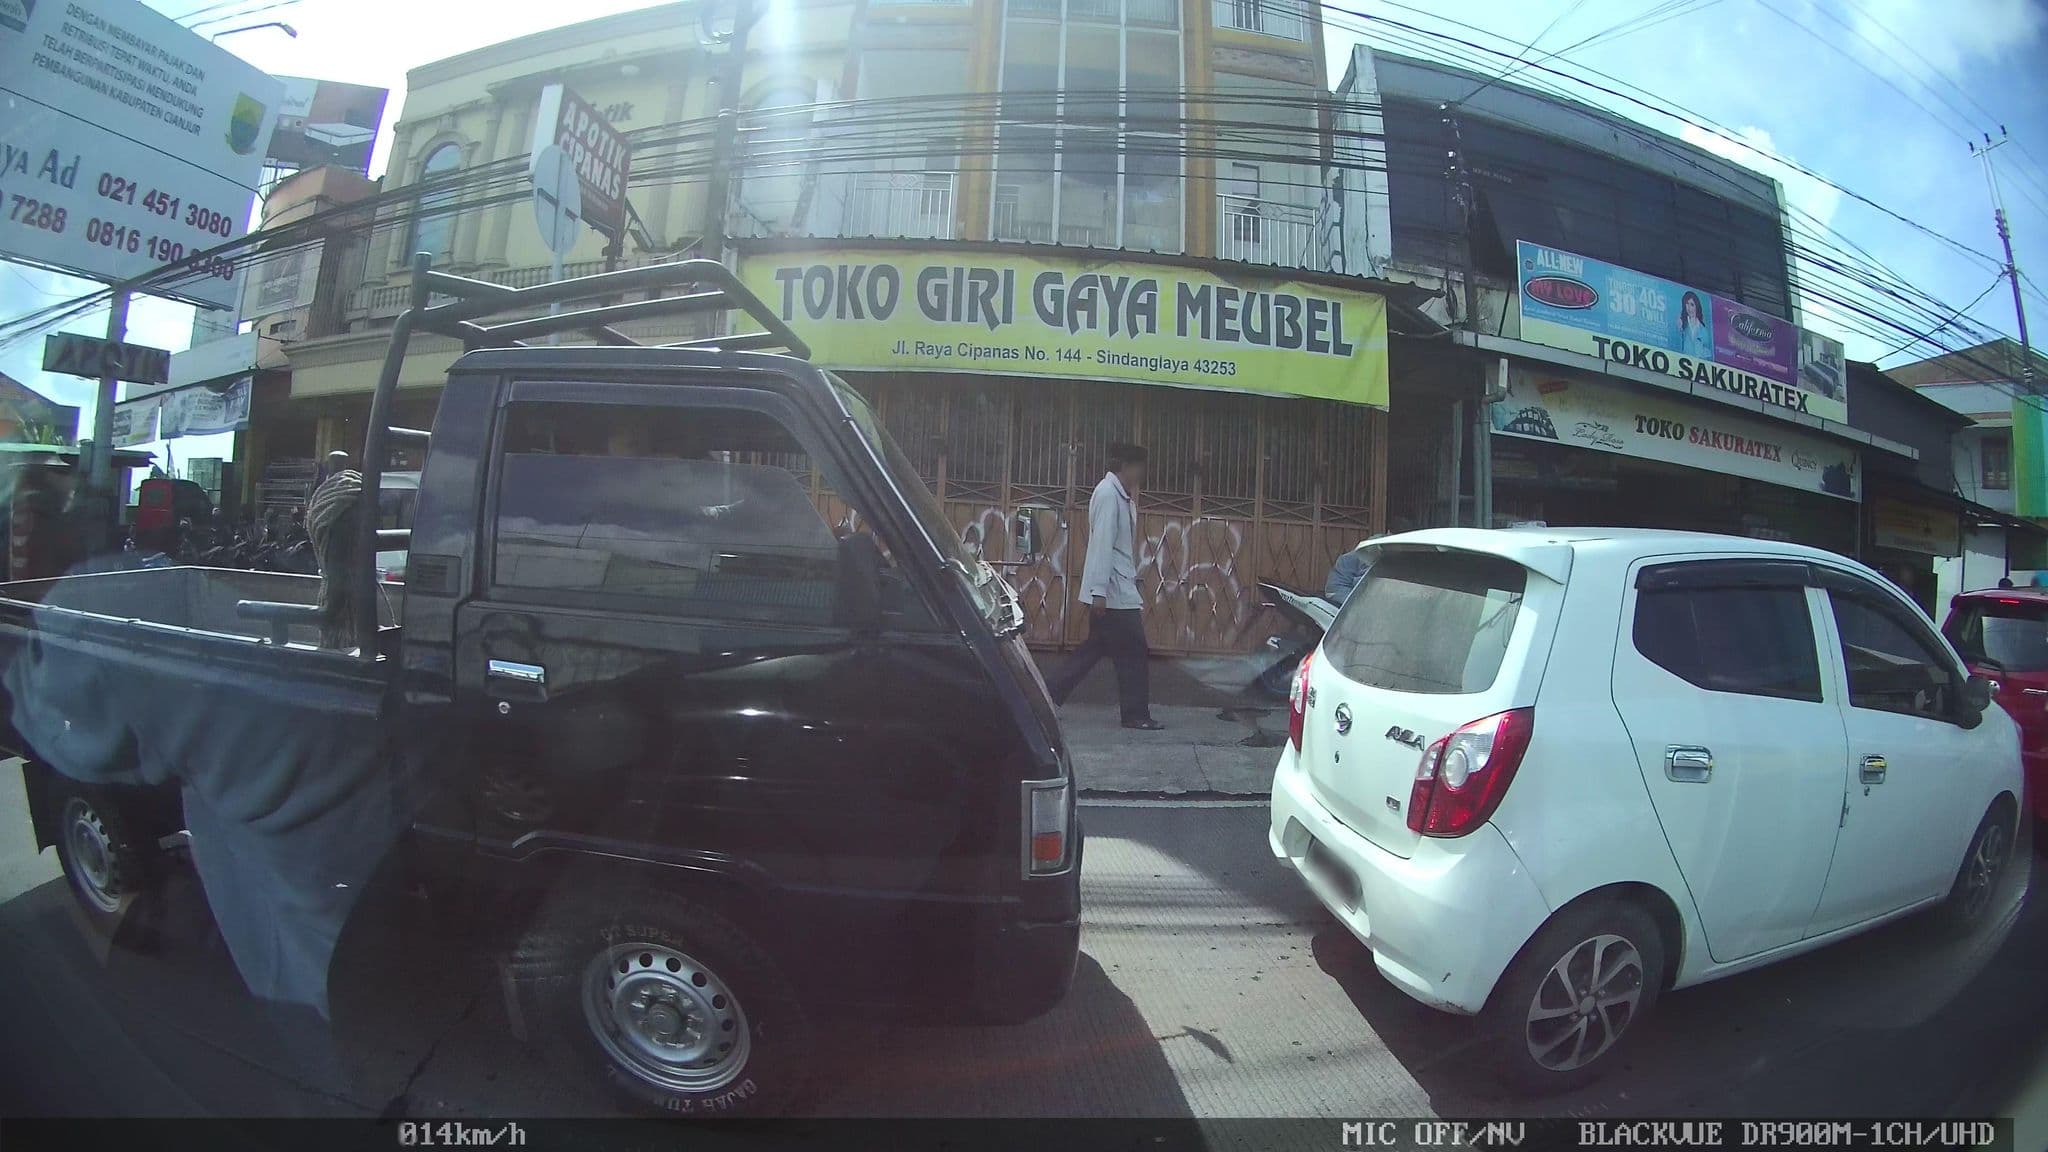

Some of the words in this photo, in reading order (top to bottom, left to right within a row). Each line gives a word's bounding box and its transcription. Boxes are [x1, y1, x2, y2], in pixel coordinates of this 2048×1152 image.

[43, 34, 73, 58] TELAH
[72, 51, 145, 92] BERPARTISIPASI
[145, 85, 204, 118] MENDUKUNG
[61, 22, 109, 54] RETRIBUSI
[111, 45, 138, 67] TEPAT
[172, 76, 198, 96] ANDA
[66, 3, 106, 31] DENGAN
[107, 22, 157, 56] MEMBAYAR
[158, 48, 187, 73] PAJAK
[186, 63, 206, 82] DAN
[32, 52, 108, 96] PEMBANGUNAN
[108, 87, 163, 119] KABUPATEN
[164, 111, 201, 136] CIANJUR
[37, 148, 81, 189] Ad
[559, 132, 622, 200] CIPANAS
[563, 101, 627, 173] APOTIK
[9, 193, 68, 233] 7288
[97, 172, 138, 205] 021
[142, 188, 181, 220] 451
[185, 203, 233, 238] 3080
[86, 218, 141, 253] 0816
[147, 236, 184, 265] 190
[775, 264, 899, 320] TOKO
[916, 266, 1014, 331] GIRI
[1033, 271, 1157, 339] GAYA
[1177, 282, 1353, 357] MEUBEL
[892, 341, 909, 355] Jl.
[915, 341, 951, 359] Raya
[957, 343, 1019, 361] Cipanas
[1025, 346, 1050, 361] No.
[1056, 348, 1081, 362] 144
[1096, 349, 1189, 373] Sindanglaya
[1193, 359, 1236, 376] 43253
[1592, 336, 1669, 374] TOKO
[1679, 357, 1808, 414] SAKURATEX
[1635, 414, 1684, 441] TOKO
[1689, 426, 1782, 463] SAKURATEX
